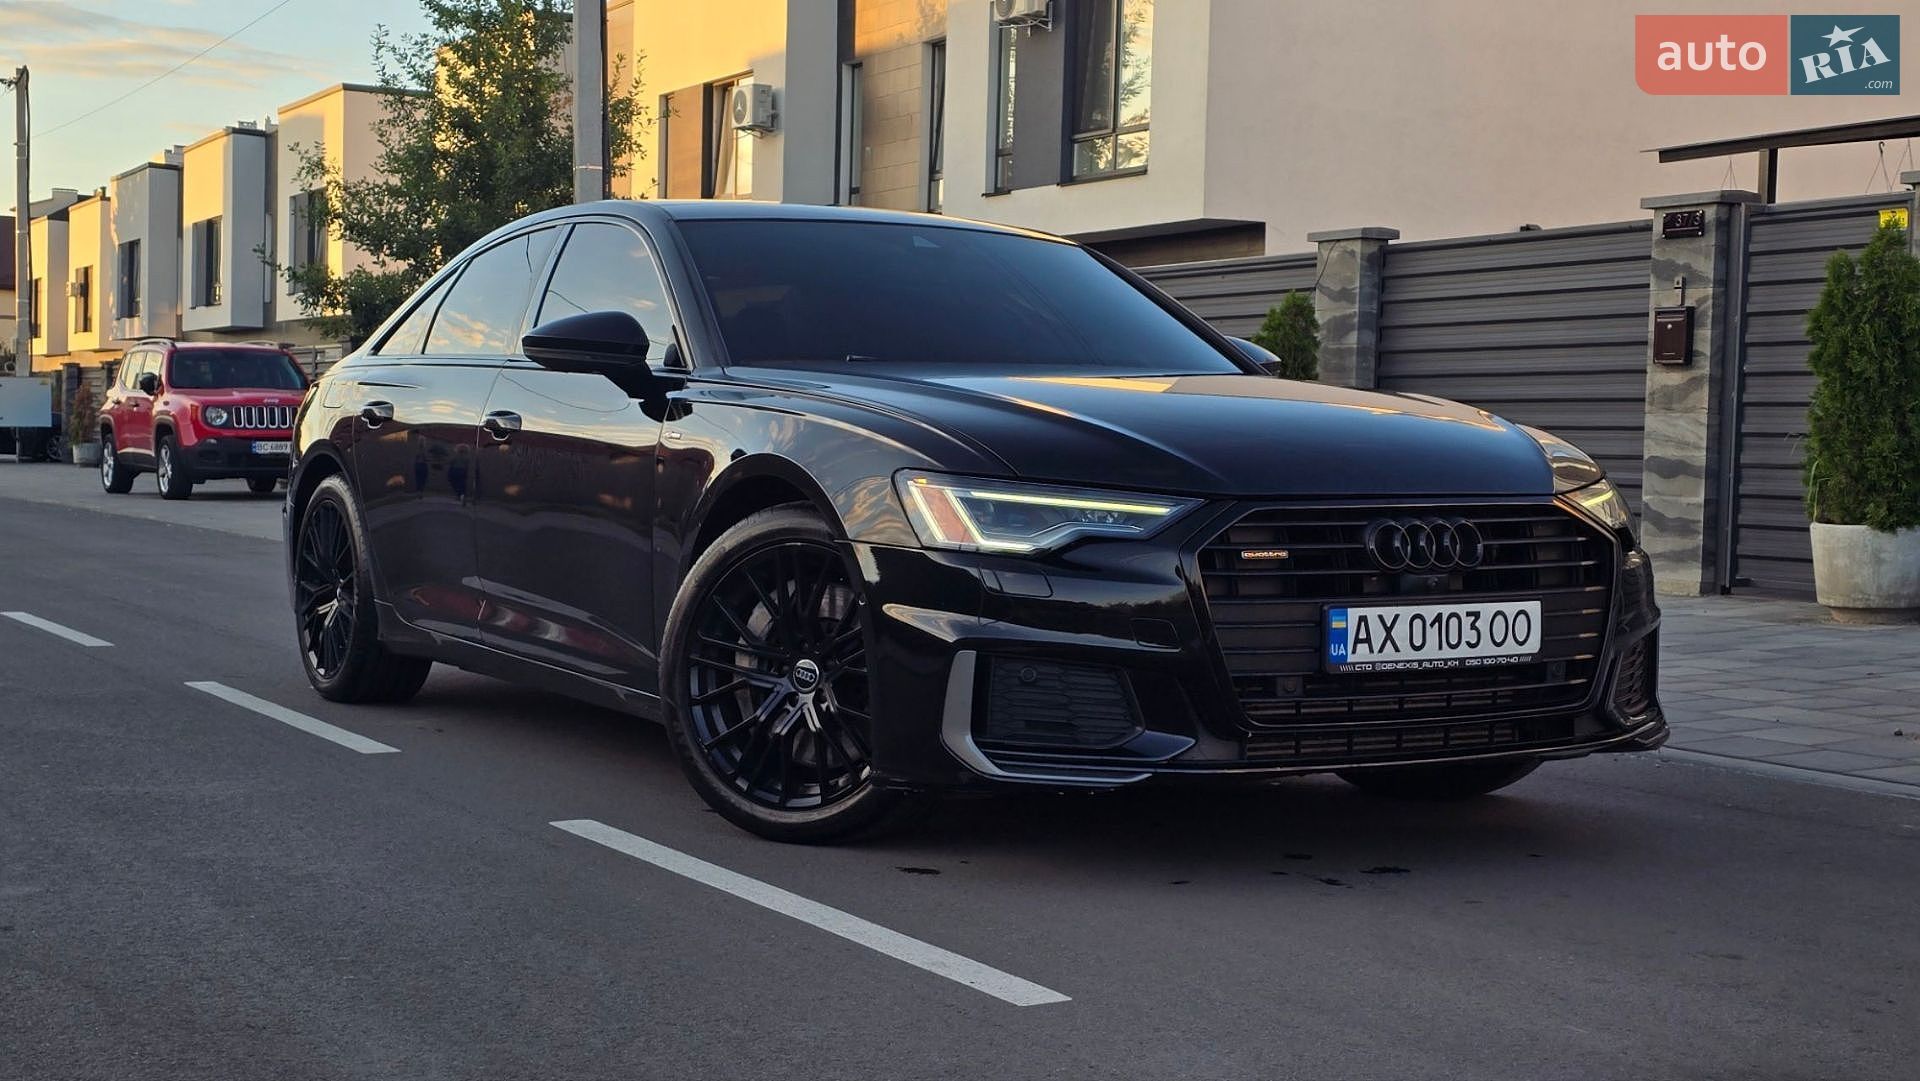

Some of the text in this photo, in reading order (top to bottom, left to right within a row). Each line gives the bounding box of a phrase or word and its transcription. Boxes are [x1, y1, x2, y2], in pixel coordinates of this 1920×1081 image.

[1243, 550, 1287, 558] quattro
[1351, 613, 1401, 655] AX
[1408, 611, 1482, 652] 0103
[1331, 643, 1346, 656] UA
